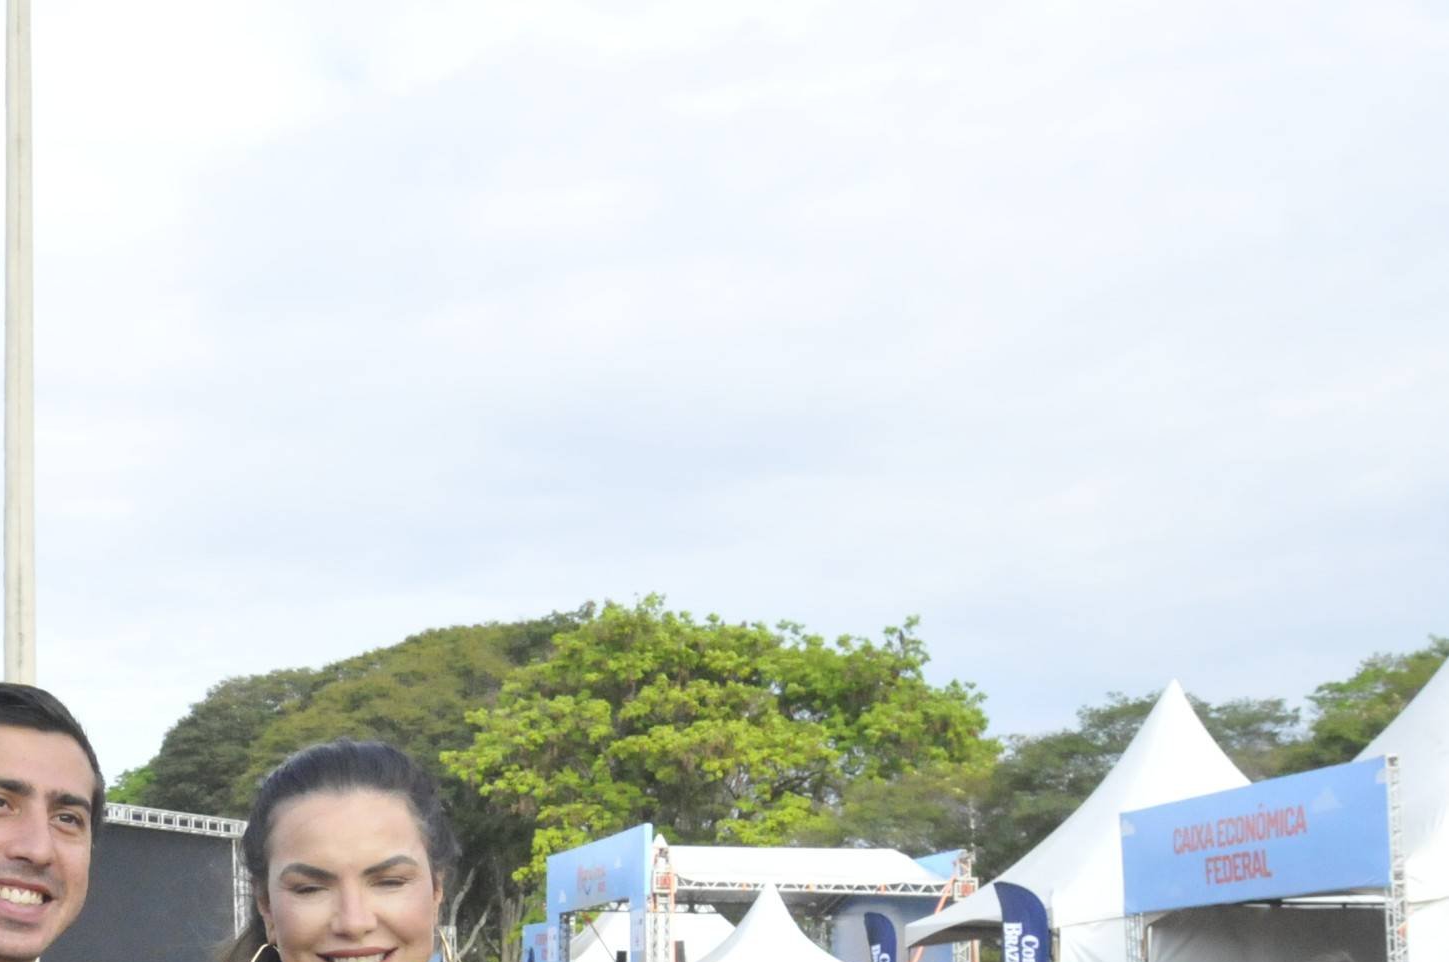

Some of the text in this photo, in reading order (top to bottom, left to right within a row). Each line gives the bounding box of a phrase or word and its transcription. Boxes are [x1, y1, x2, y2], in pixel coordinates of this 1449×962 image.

[1173, 803, 1307, 854] CAIXA ECONÔMICA
[1205, 849, 1272, 885] FEDERAL
